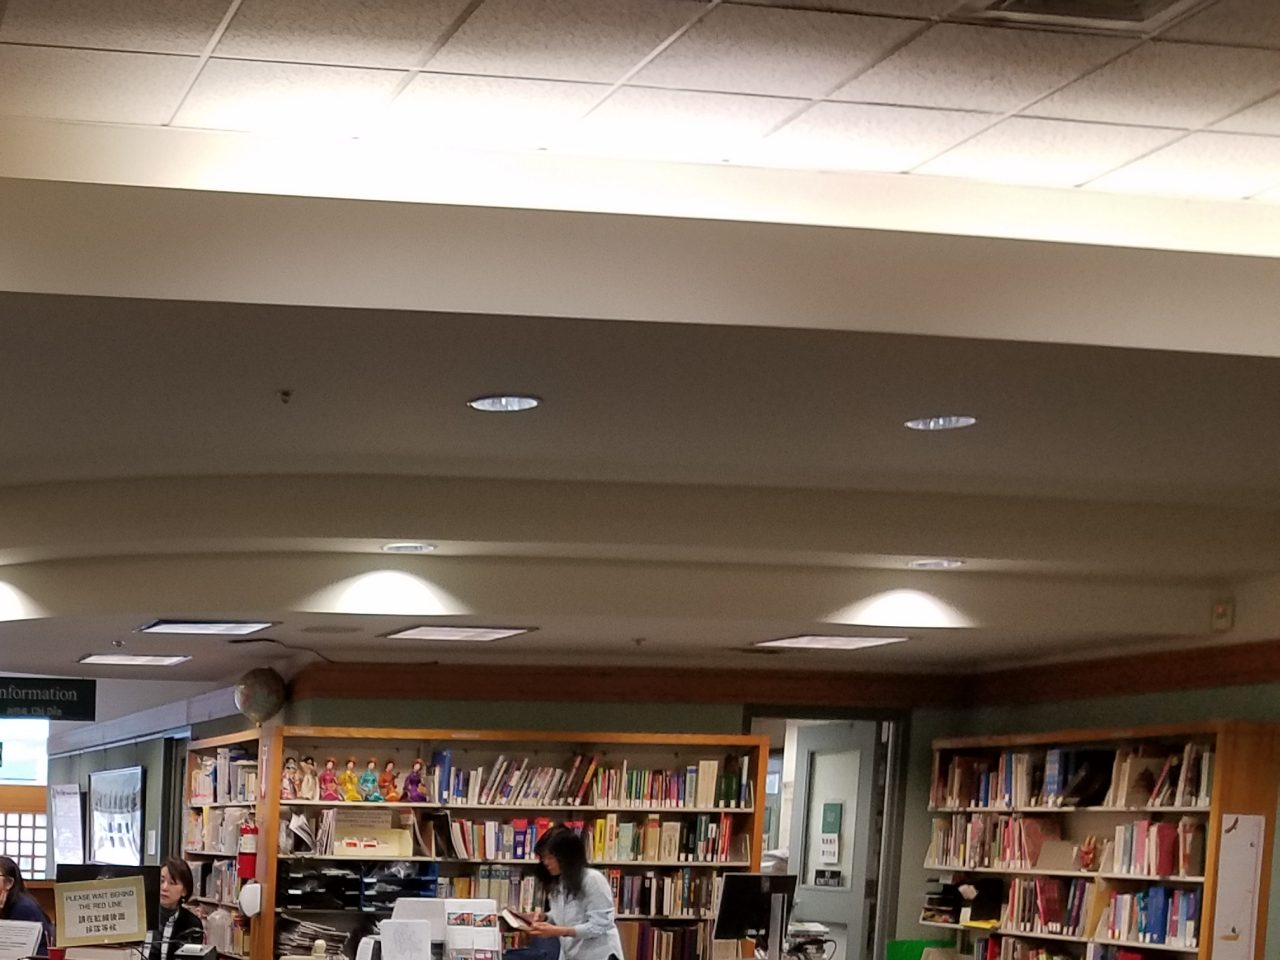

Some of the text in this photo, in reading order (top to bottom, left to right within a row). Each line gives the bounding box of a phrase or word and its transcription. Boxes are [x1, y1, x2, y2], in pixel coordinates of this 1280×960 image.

[65, 890, 134, 902] PLEASE WAIT BEHIND
